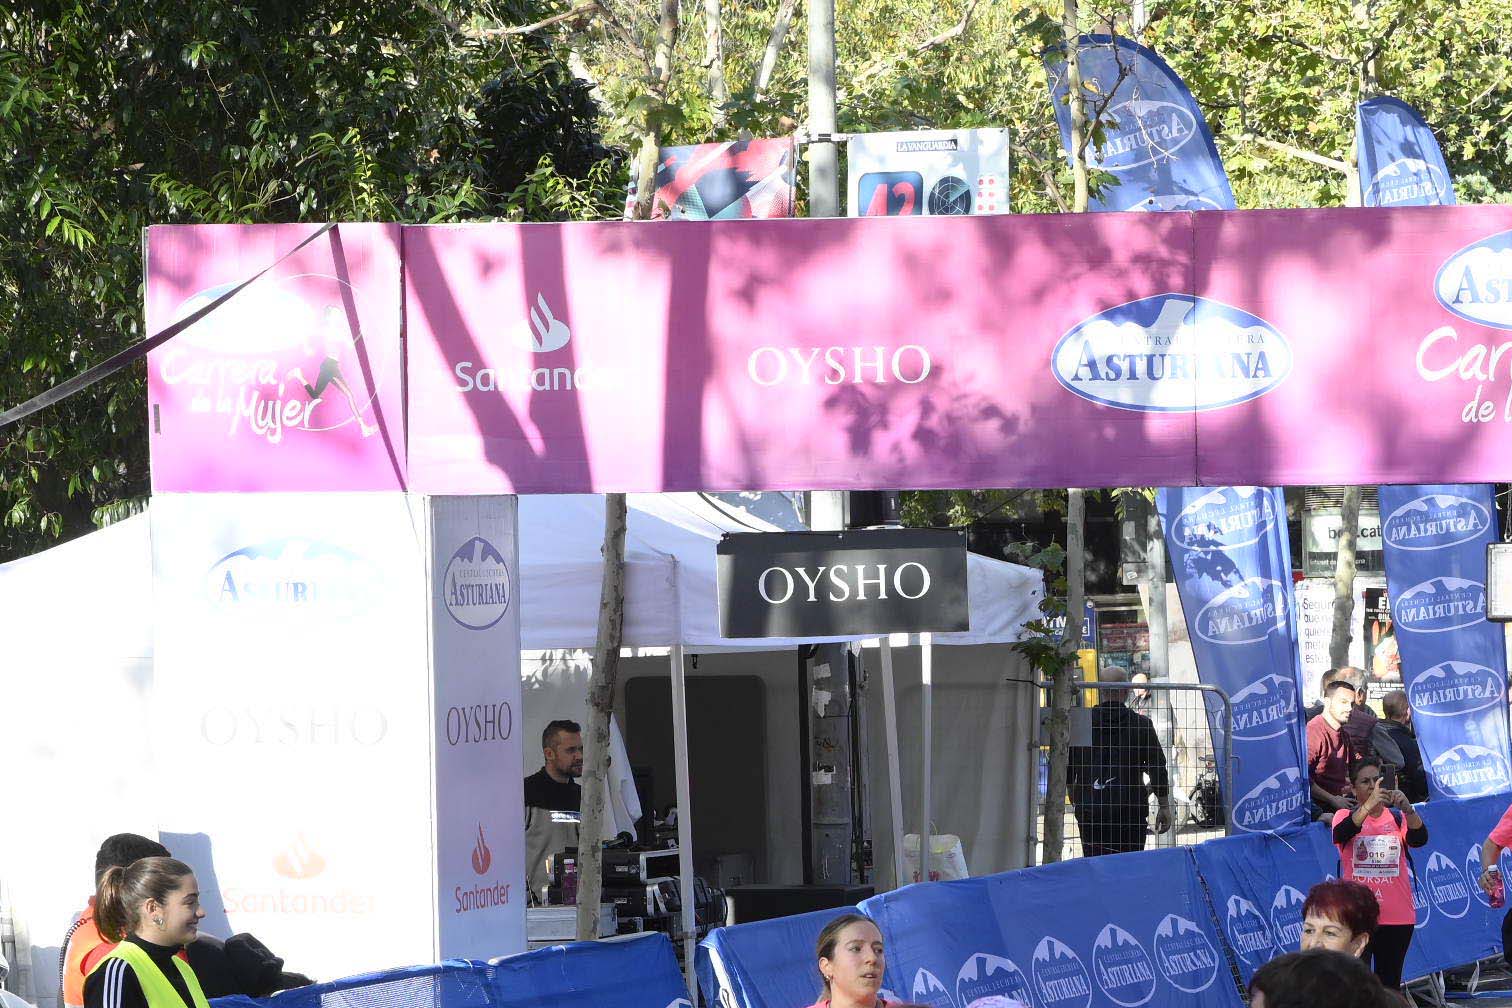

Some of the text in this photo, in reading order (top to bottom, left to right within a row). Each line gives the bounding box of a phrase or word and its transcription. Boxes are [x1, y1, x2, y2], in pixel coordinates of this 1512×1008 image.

[866, 182, 915, 216] 42
[748, 345, 932, 387] OYSHO
[1071, 338, 1273, 382] ASTURNA
[1461, 384, 1498, 424] de
[1328, 525, 1381, 540] b.cat
[449, 571, 507, 607] ASTURIANA
[757, 560, 932, 606] OYSHO
[446, 702, 513, 746] OYSHO
[454, 882, 511, 915] Santander
[1037, 971, 1090, 1004] ASTURIANA
[1097, 957, 1153, 990] ASTURIANA
